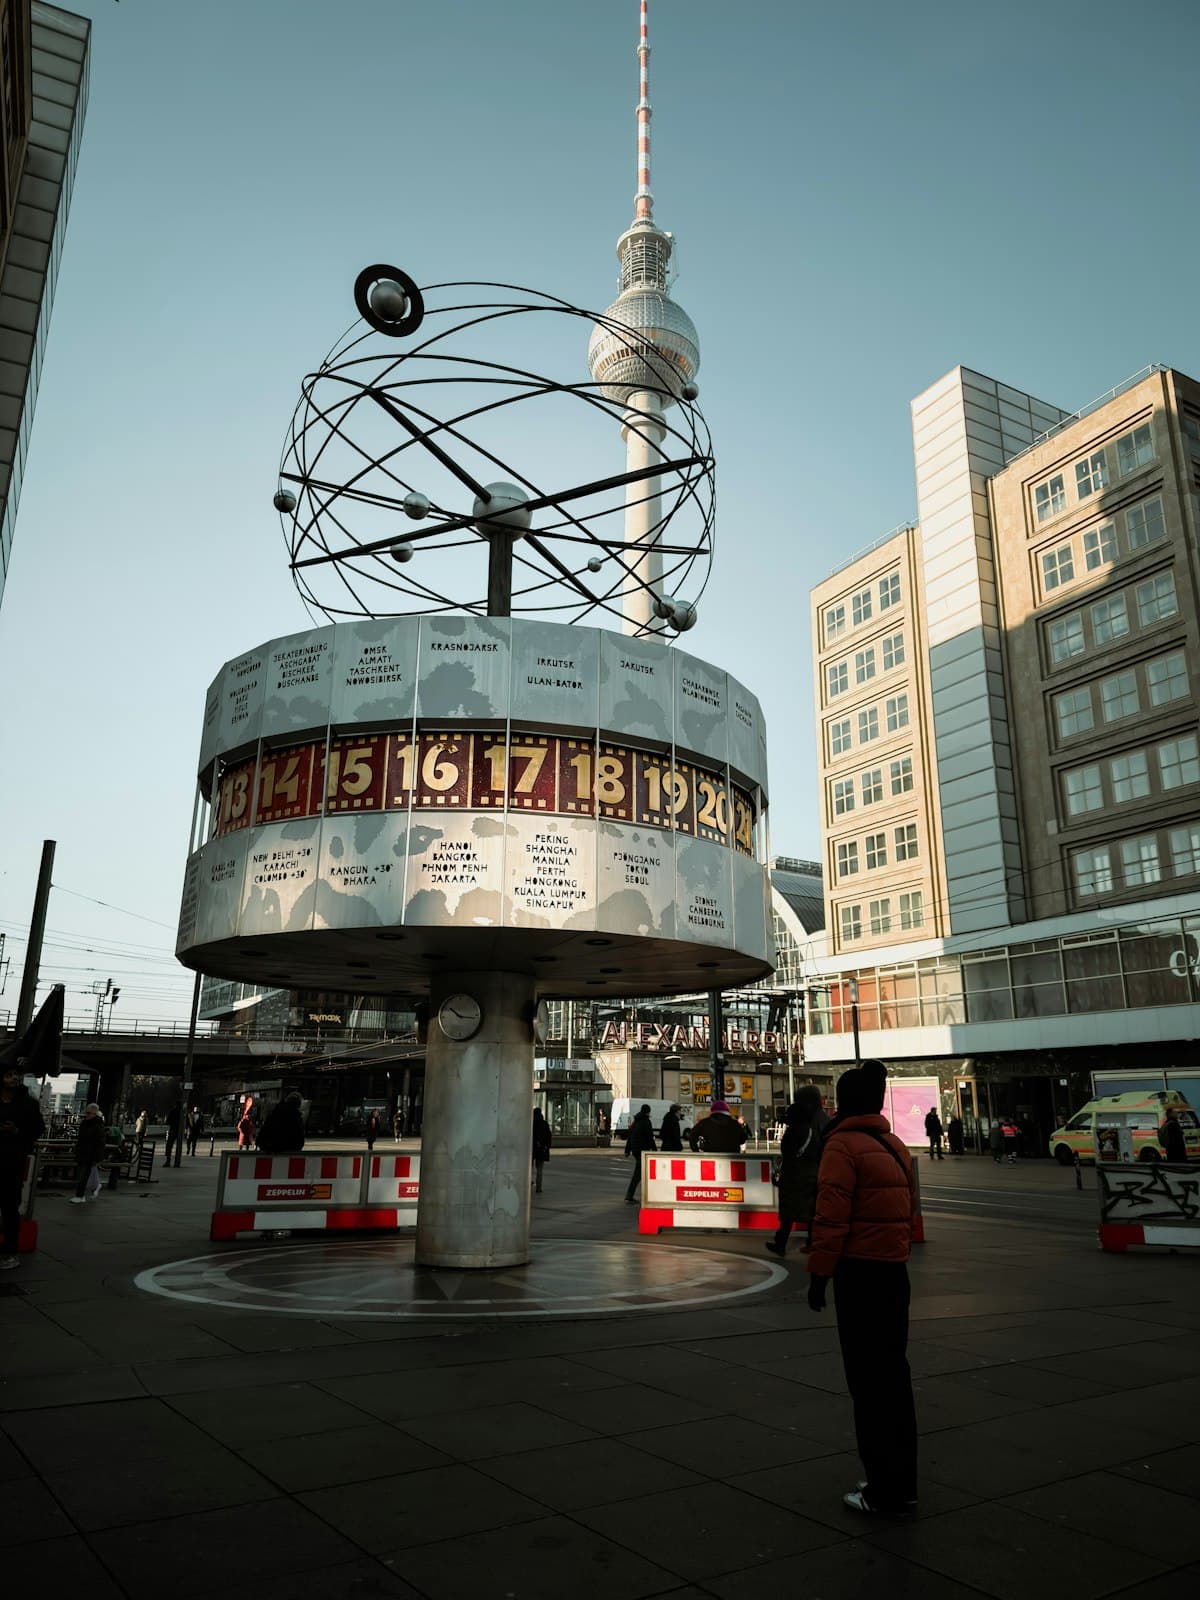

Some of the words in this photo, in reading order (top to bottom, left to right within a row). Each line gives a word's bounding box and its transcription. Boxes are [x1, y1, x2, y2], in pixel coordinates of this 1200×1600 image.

[273, 642, 328, 663] JEKATERINBURG
[364, 646, 387, 655] OMSK
[431, 643, 499, 652] KRASNOJARSK
[279, 654, 321, 670] ASCHGABAT
[358, 655, 392, 665] ALMATY
[537, 657, 575, 669] IRKUTSK
[282, 665, 316, 679] BISCHKEK
[350, 664, 401, 676] TASCHKENT
[620, 660, 655, 676] JAKUTSK
[277, 673, 319, 689] DUSCHANBE
[346, 674, 402, 687] NOWOSIBIRSK
[527, 676, 584, 690] ULAN-BATOR
[682, 678, 720, 699] CHABAROWSK
[682, 686, 721, 708] WLADIWOSTOK
[223, 772, 248, 822] 13
[260, 757, 299, 808] 14
[320, 747, 373, 797] 15
[396, 743, 459, 791] 16
[484, 745, 548, 793] 17
[570, 753, 626, 805] 18
[643, 766, 688, 815] 19
[698, 781, 732, 835] 20
[535, 834, 569, 844] PEKING
[440, 842, 472, 850] HANOI
[526, 845, 577, 856] SHANGHAI
[253, 853, 269, 864] NEW
[272, 850, 295, 861] DELHI
[433, 853, 478, 862] BANGKOK
[532, 855, 570, 866] MANILA
[263, 861, 299, 872] KARACHI
[330, 865, 369, 876] RANGUN
[422, 864, 457, 872] PHNOM
[463, 864, 488, 872] PENH
[537, 867, 566, 876] PERTH
[626, 865, 648, 875] TOKYO
[254, 872, 287, 884] COLOMBO
[343, 877, 377, 886] DHAKA
[431, 874, 477, 883] JAKARTA
[525, 877, 577, 887] HONGKONG
[625, 875, 649, 886] SEOUL
[514, 887, 545, 897] KUALA
[551, 889, 587, 899] LUMPUR
[526, 899, 574, 910] SINGAPUR
[695, 896, 717, 907] SYDNEY
[689, 905, 723, 918] CANBERRA
[688, 915, 725, 929] MELBOURNE
[601, 1020, 803, 1053] ALEXANERPL
[547, 1058, 556, 1069] U
[266, 1188, 305, 1196] ZEPPELIN
[683, 1190, 720, 1198] ZEPPELIN
